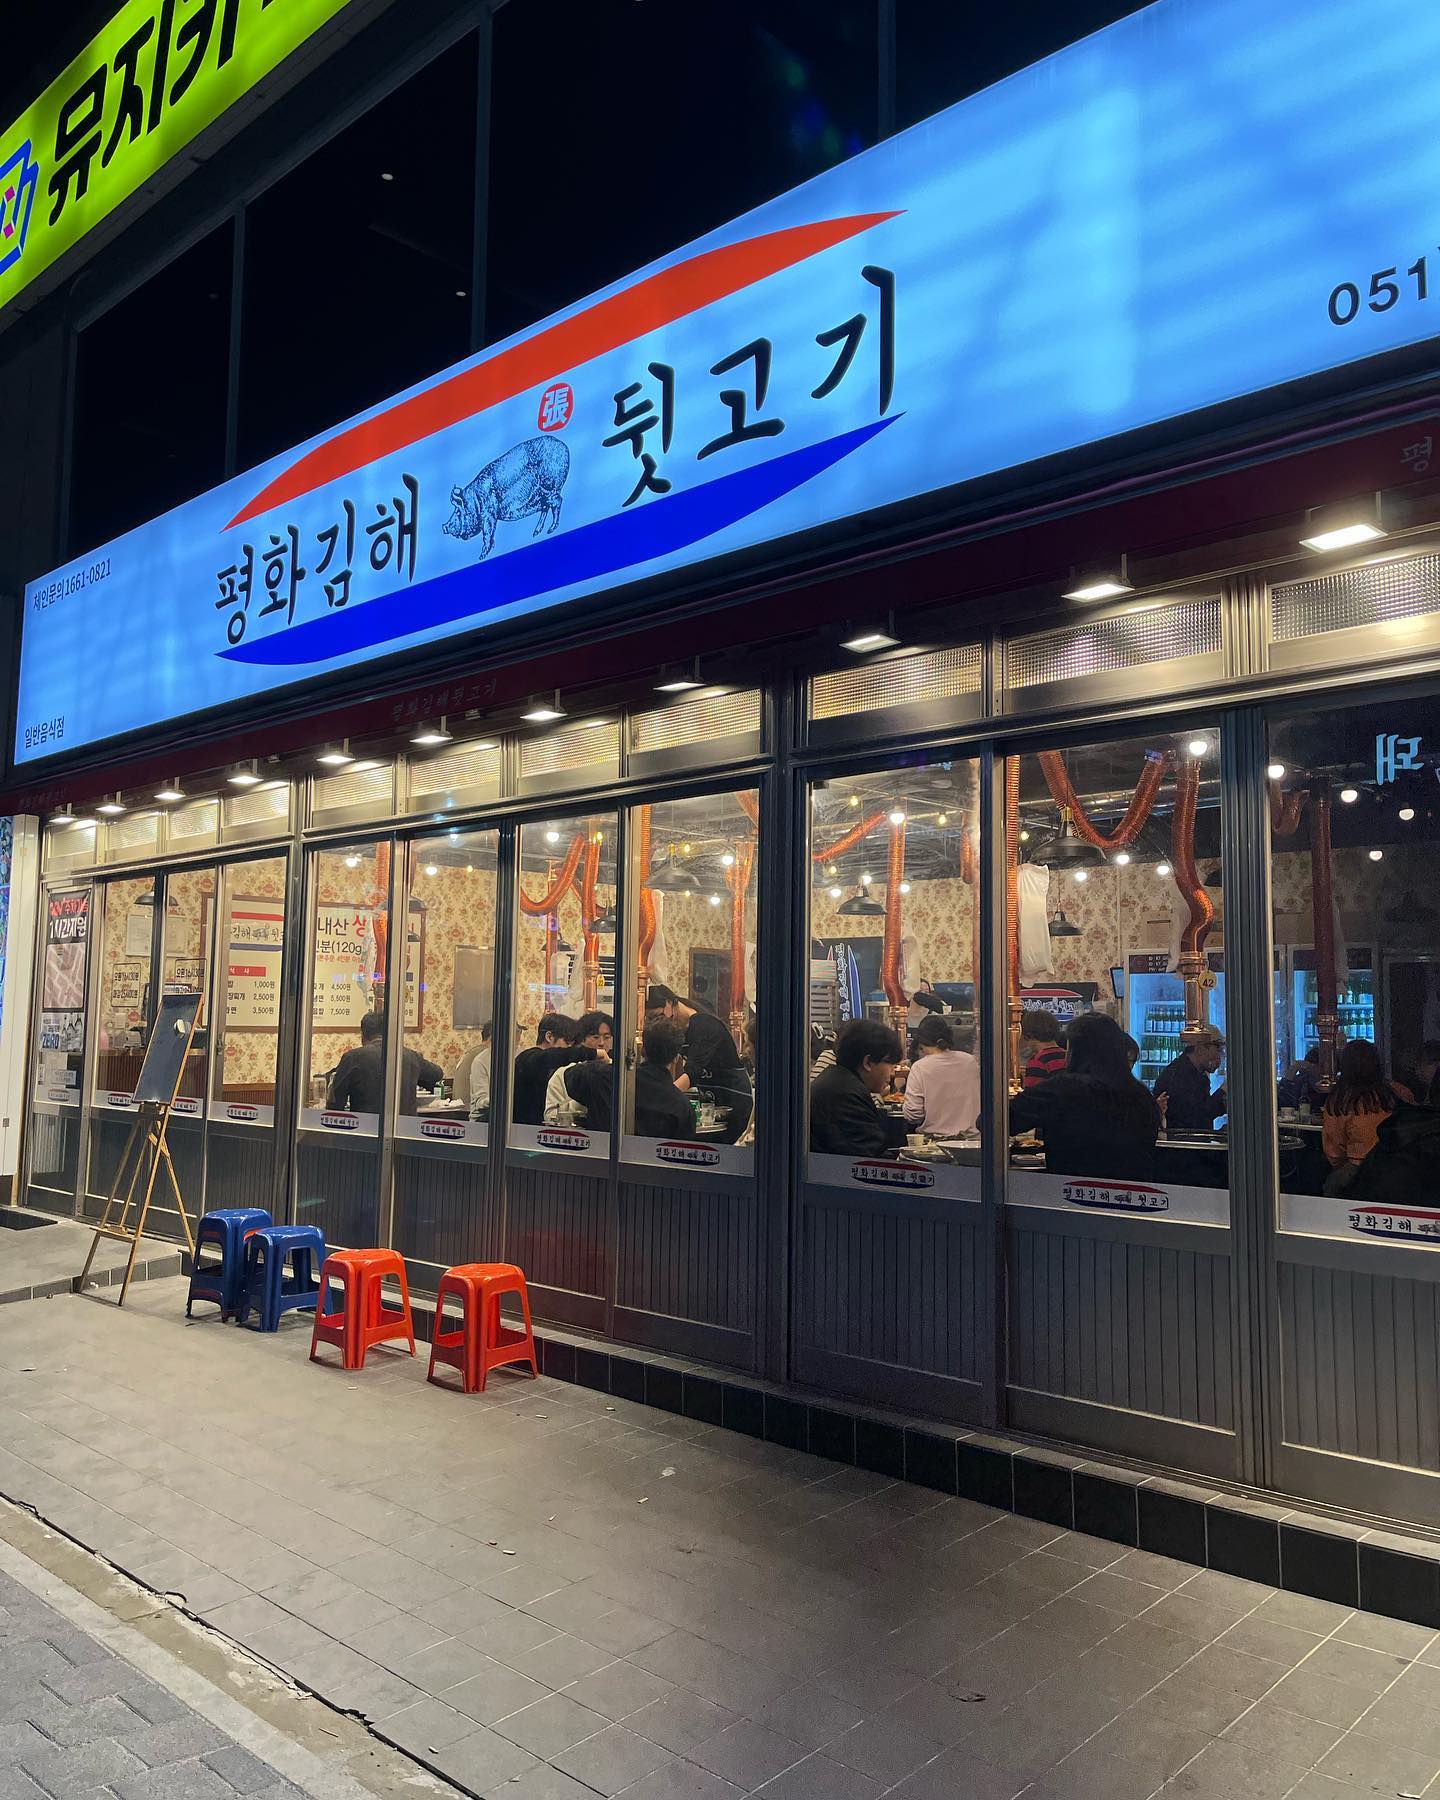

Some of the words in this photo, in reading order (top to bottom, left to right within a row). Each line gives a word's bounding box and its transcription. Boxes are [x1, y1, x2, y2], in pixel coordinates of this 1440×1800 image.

[215, 472, 420, 645] 평화김해
[602, 265, 895, 508] 뒷고기
[25, 716, 65, 748] 일반음식점
[254, 981, 275, 989] 1,000원
[253, 993, 274, 1001] 2,500원
[1063, 1187, 1110, 1204] 평화김해
[1138, 1194, 1169, 1209] 뒷고기
[1348, 1213, 1412, 1232] 평화김해
